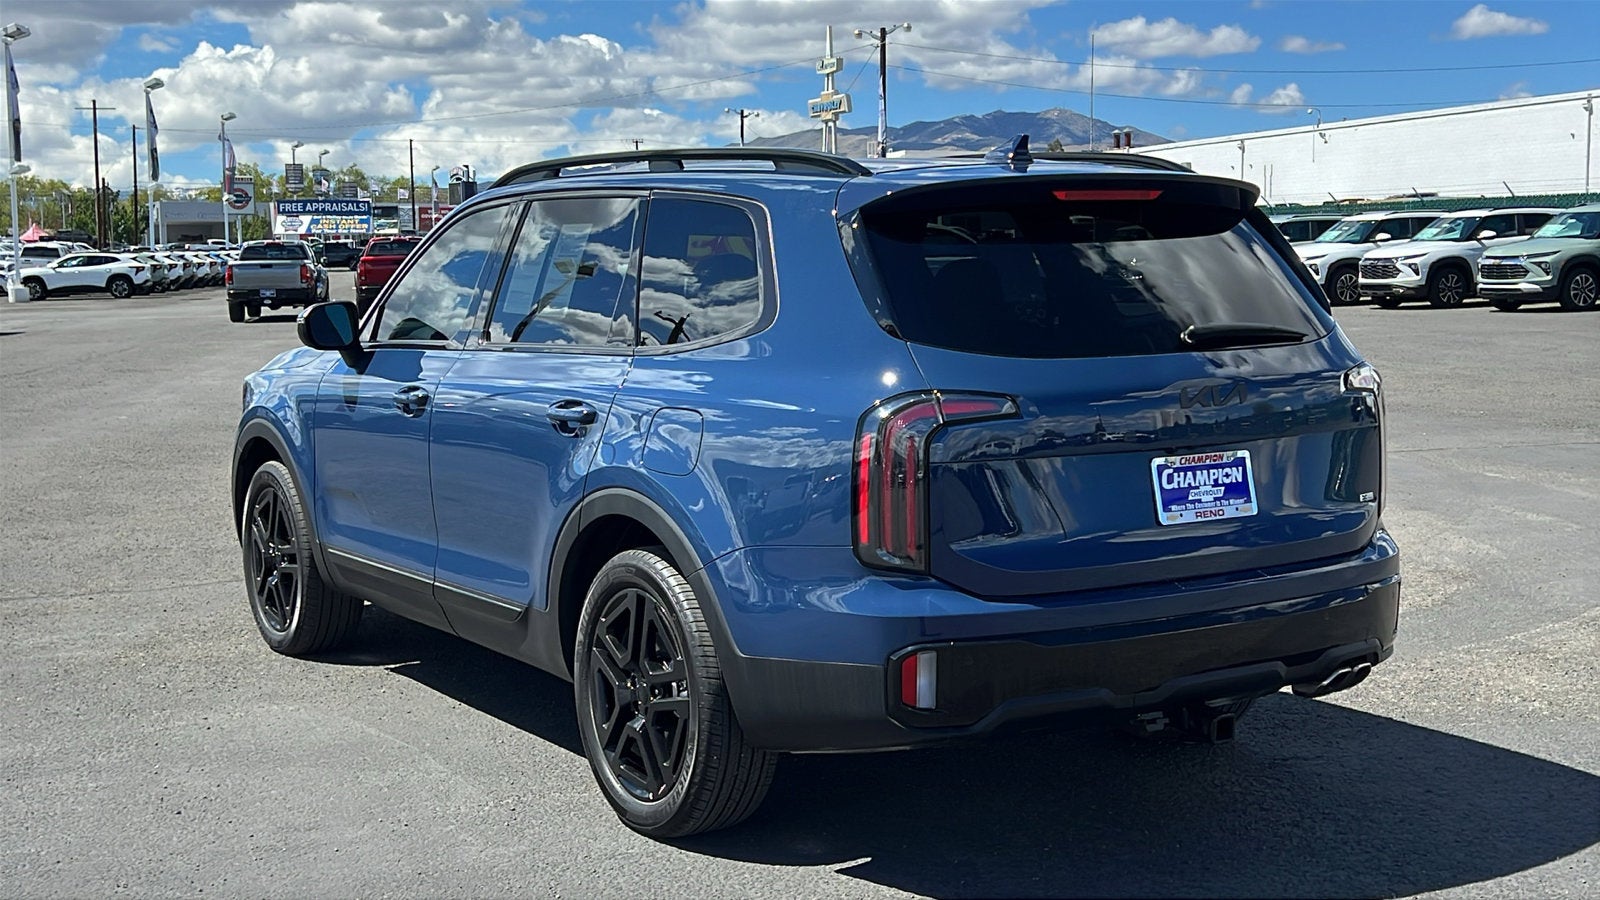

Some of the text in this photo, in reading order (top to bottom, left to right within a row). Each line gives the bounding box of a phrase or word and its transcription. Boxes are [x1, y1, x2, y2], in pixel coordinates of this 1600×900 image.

[280, 202, 368, 212] FREE APPRAISALS!
[1179, 453, 1224, 465] CHAMPION
[1189, 488, 1223, 498] CHEVROLET
[1195, 508, 1225, 519] RENO
